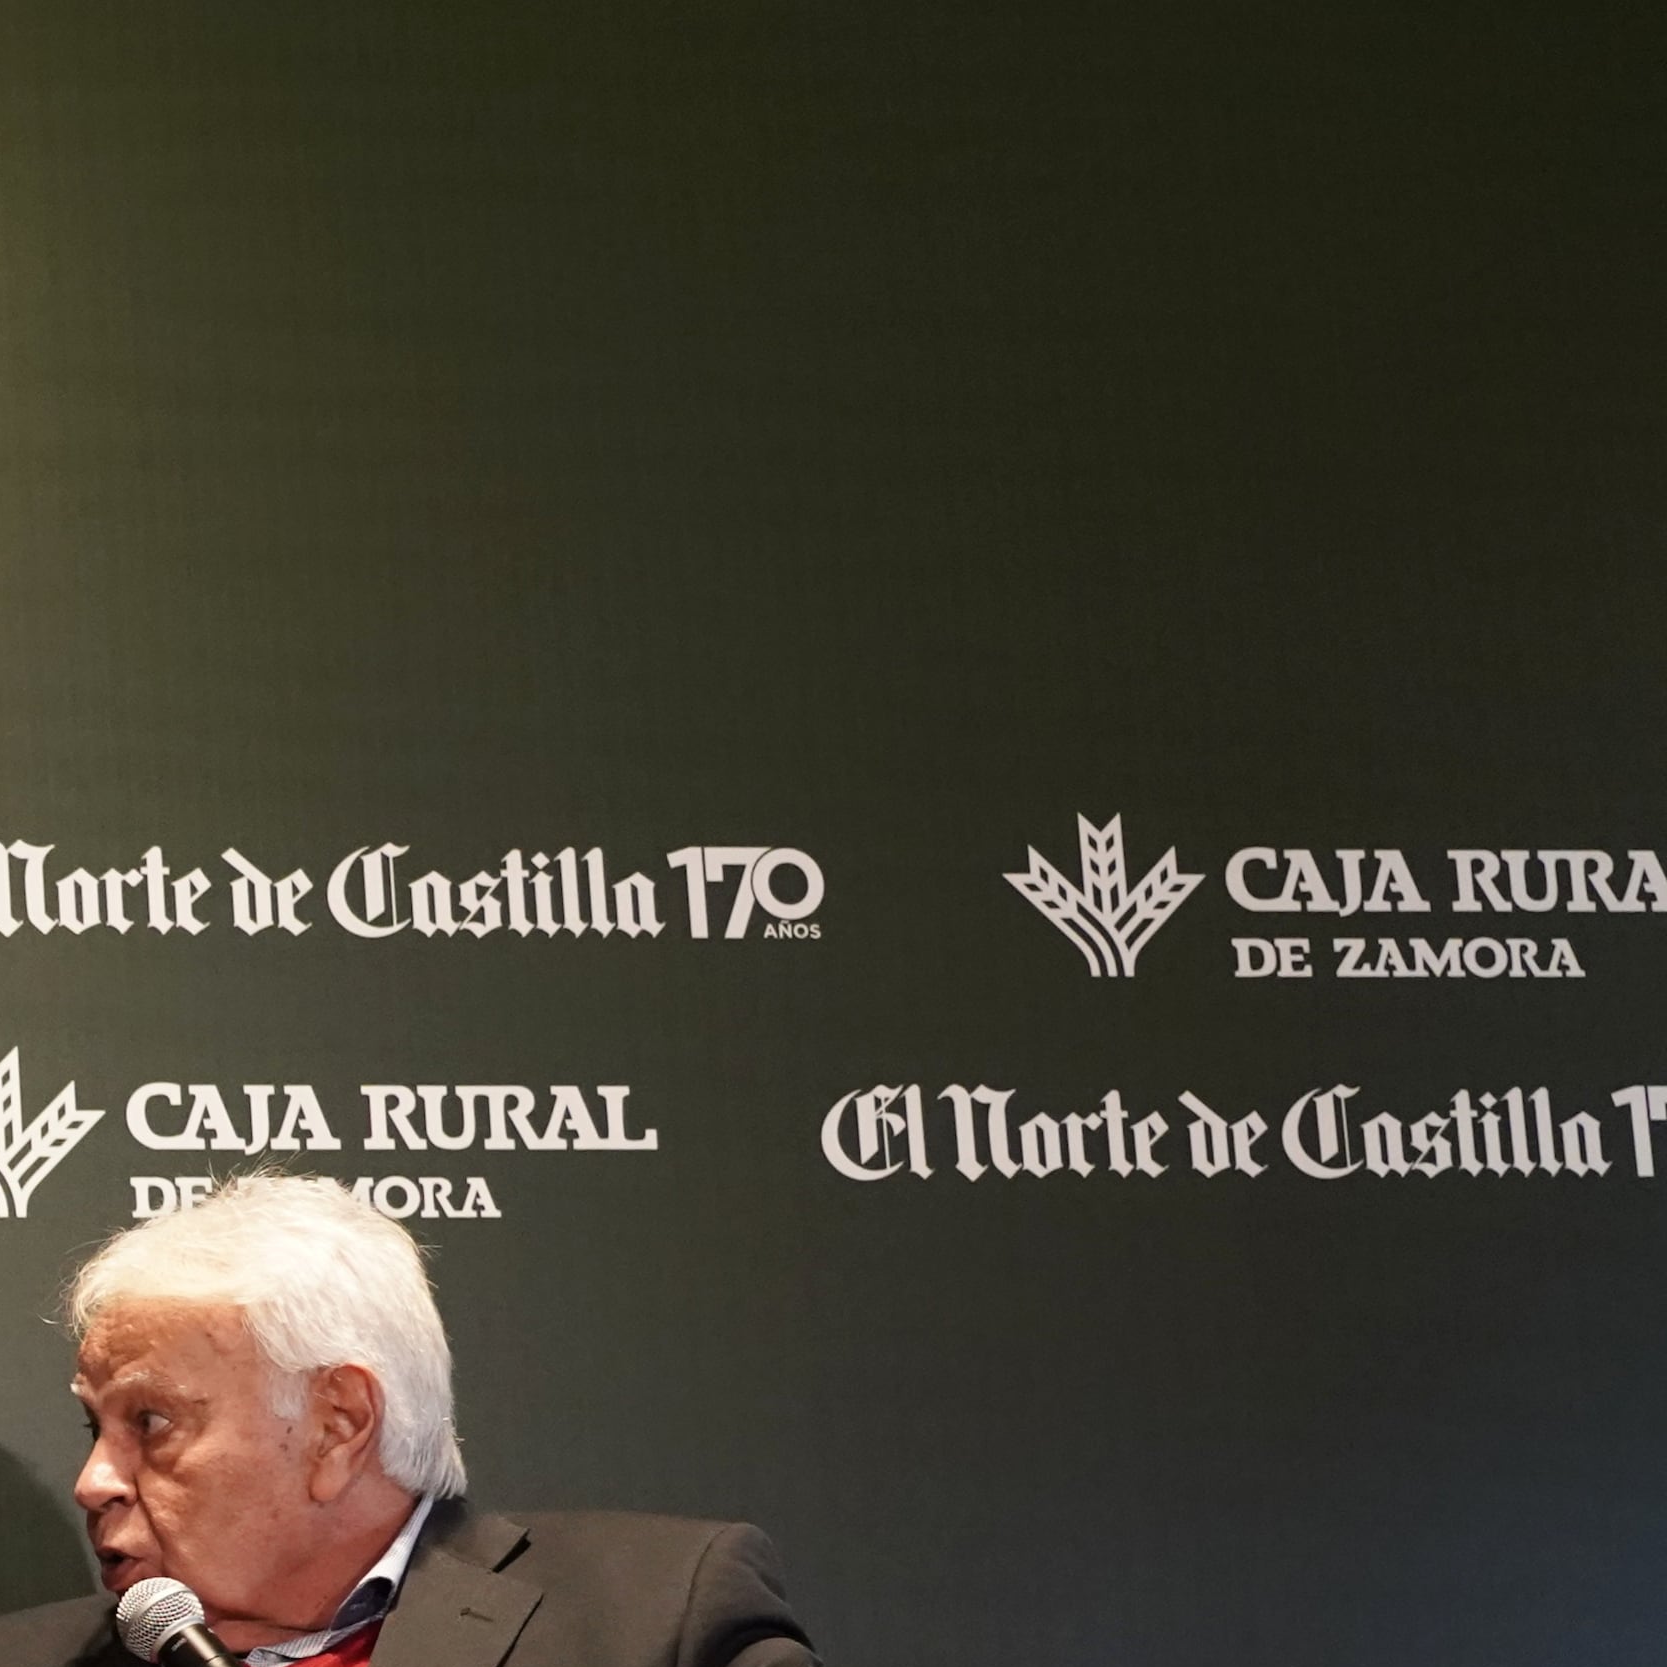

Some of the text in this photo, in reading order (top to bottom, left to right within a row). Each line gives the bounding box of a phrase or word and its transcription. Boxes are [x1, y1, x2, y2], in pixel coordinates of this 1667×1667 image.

[221, 847, 314, 937] de
[326, 842, 666, 939] Castilla
[666, 846, 825, 939] 170
[1225, 846, 1431, 917] CAJA
[763, 916, 822, 940] AÑOS
[1231, 936, 1586, 979] DE ZAMORA
[125, 1081, 658, 1156] CAJA RURAL
[821, 1083, 934, 1181] El
[937, 1083, 1169, 1182] Norte
[1178, 1090, 1268, 1178] de
[1281, 1083, 1612, 1179] Castilla
[129, 1176, 213, 1219] DE
